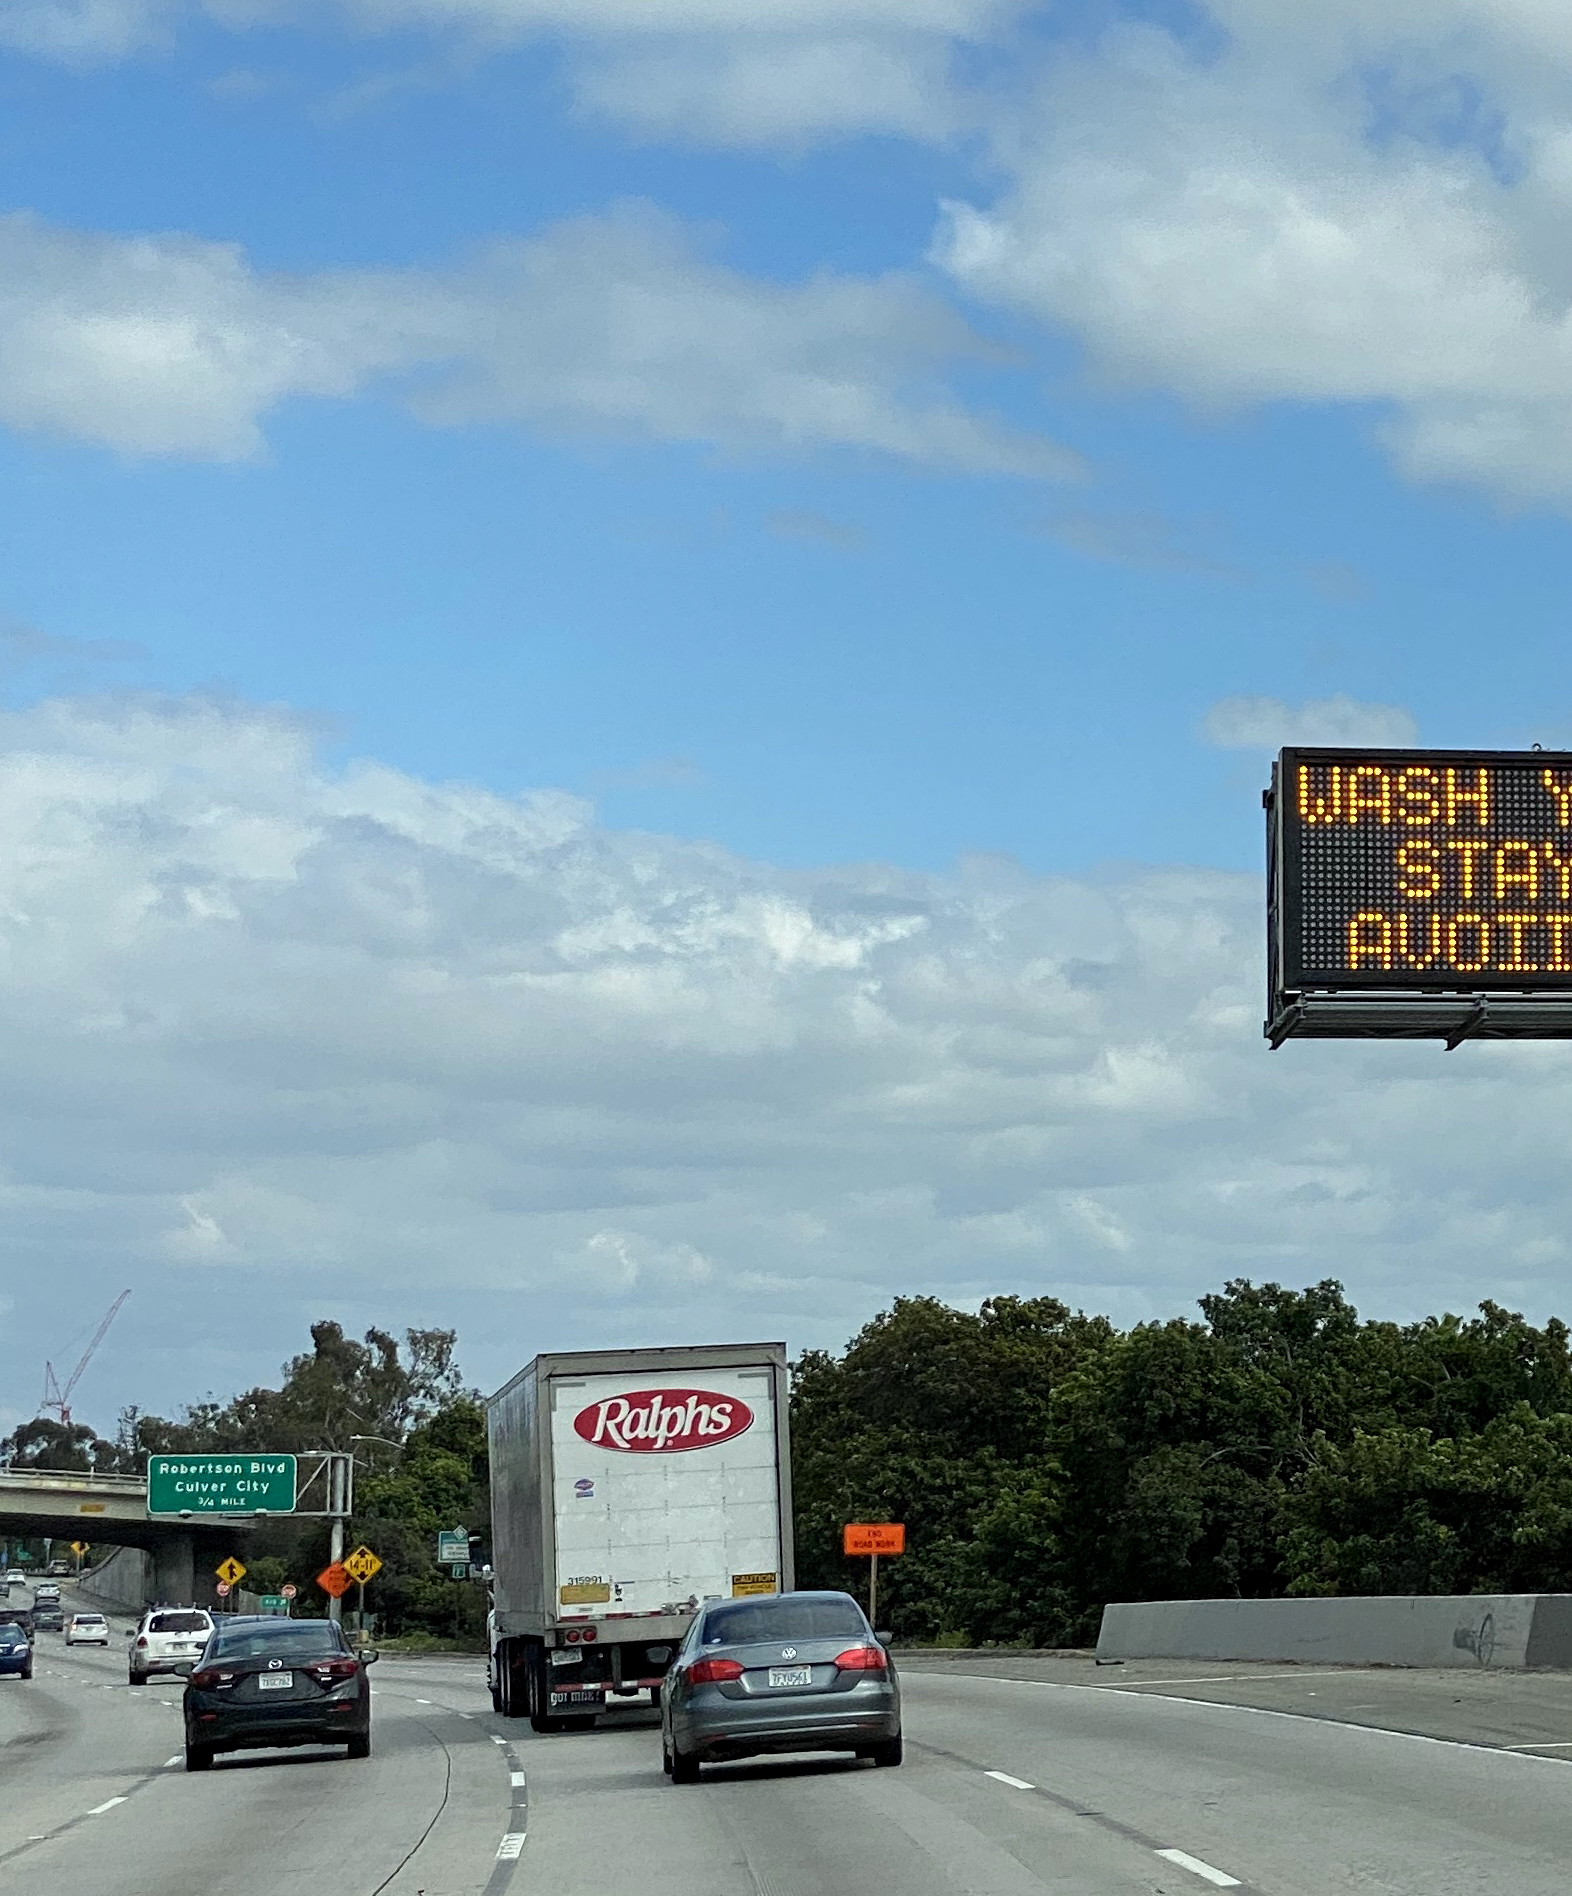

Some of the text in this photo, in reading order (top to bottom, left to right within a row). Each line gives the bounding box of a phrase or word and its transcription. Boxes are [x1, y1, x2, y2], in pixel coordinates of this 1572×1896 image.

[1298, 765, 1489, 826] WASH
[591, 1395, 733, 1449] Ralphs
[159, 1462, 286, 1474] Robertson Blvd
[175, 1480, 270, 1494] Culver City
[221, 1498, 246, 1506] MILE
[733, 1574, 775, 1583] CAUTION
